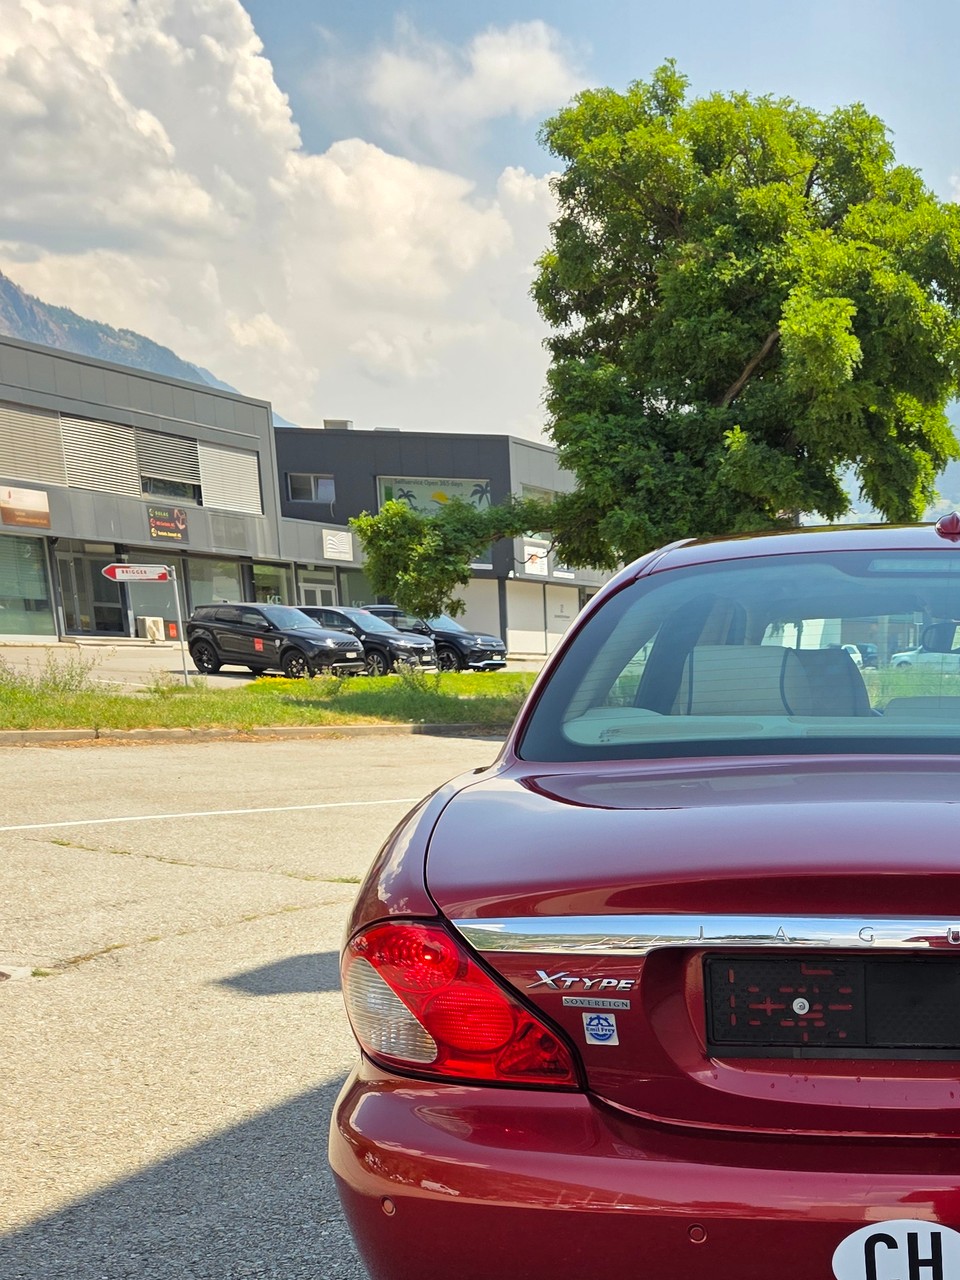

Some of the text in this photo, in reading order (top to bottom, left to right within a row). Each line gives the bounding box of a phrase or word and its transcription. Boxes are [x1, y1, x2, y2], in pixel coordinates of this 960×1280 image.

[563, 998, 630, 1009] SOVEREIGN
[586, 1026, 615, 1035] Emil Frey
